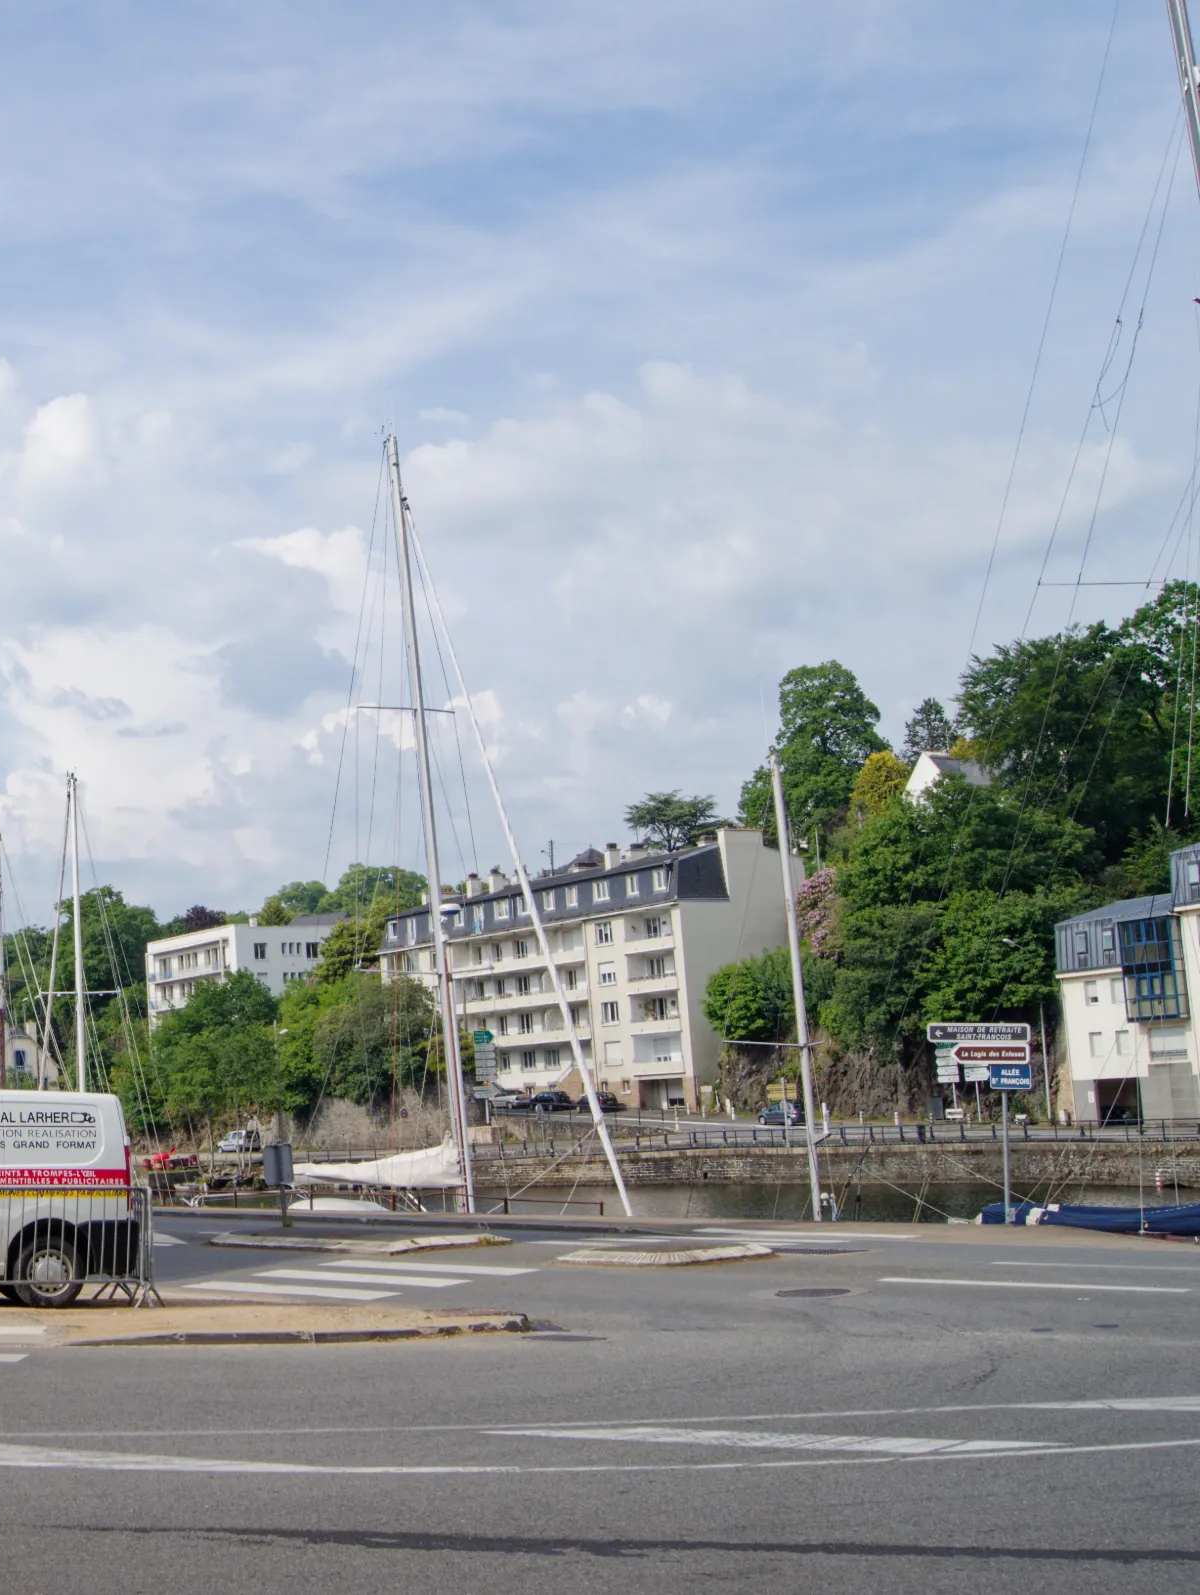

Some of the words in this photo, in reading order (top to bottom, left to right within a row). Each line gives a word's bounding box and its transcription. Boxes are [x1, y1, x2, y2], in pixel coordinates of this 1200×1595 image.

[989, 1026, 1022, 1034] RETRAITE
[956, 1033, 1012, 1041] SAINT-FRANÇOIS
[961, 1050, 969, 1058] Le
[970, 1050, 986, 1059] Logis
[988, 1050, 1000, 1058] des
[1000, 1067, 1020, 1076] ALLÉE
[1000, 1077, 1030, 1086] FRANÇOIS
[19, 1111, 70, 1124] LARHER
[27, 1128, 97, 1139] REALISATION
[12, 1140, 50, 1149] GRAND
[56, 1140, 97, 1149] FORMAT
[53, 1177, 59, 1185] &
[61, 1176, 125, 1186] PUBLICITAIRES
